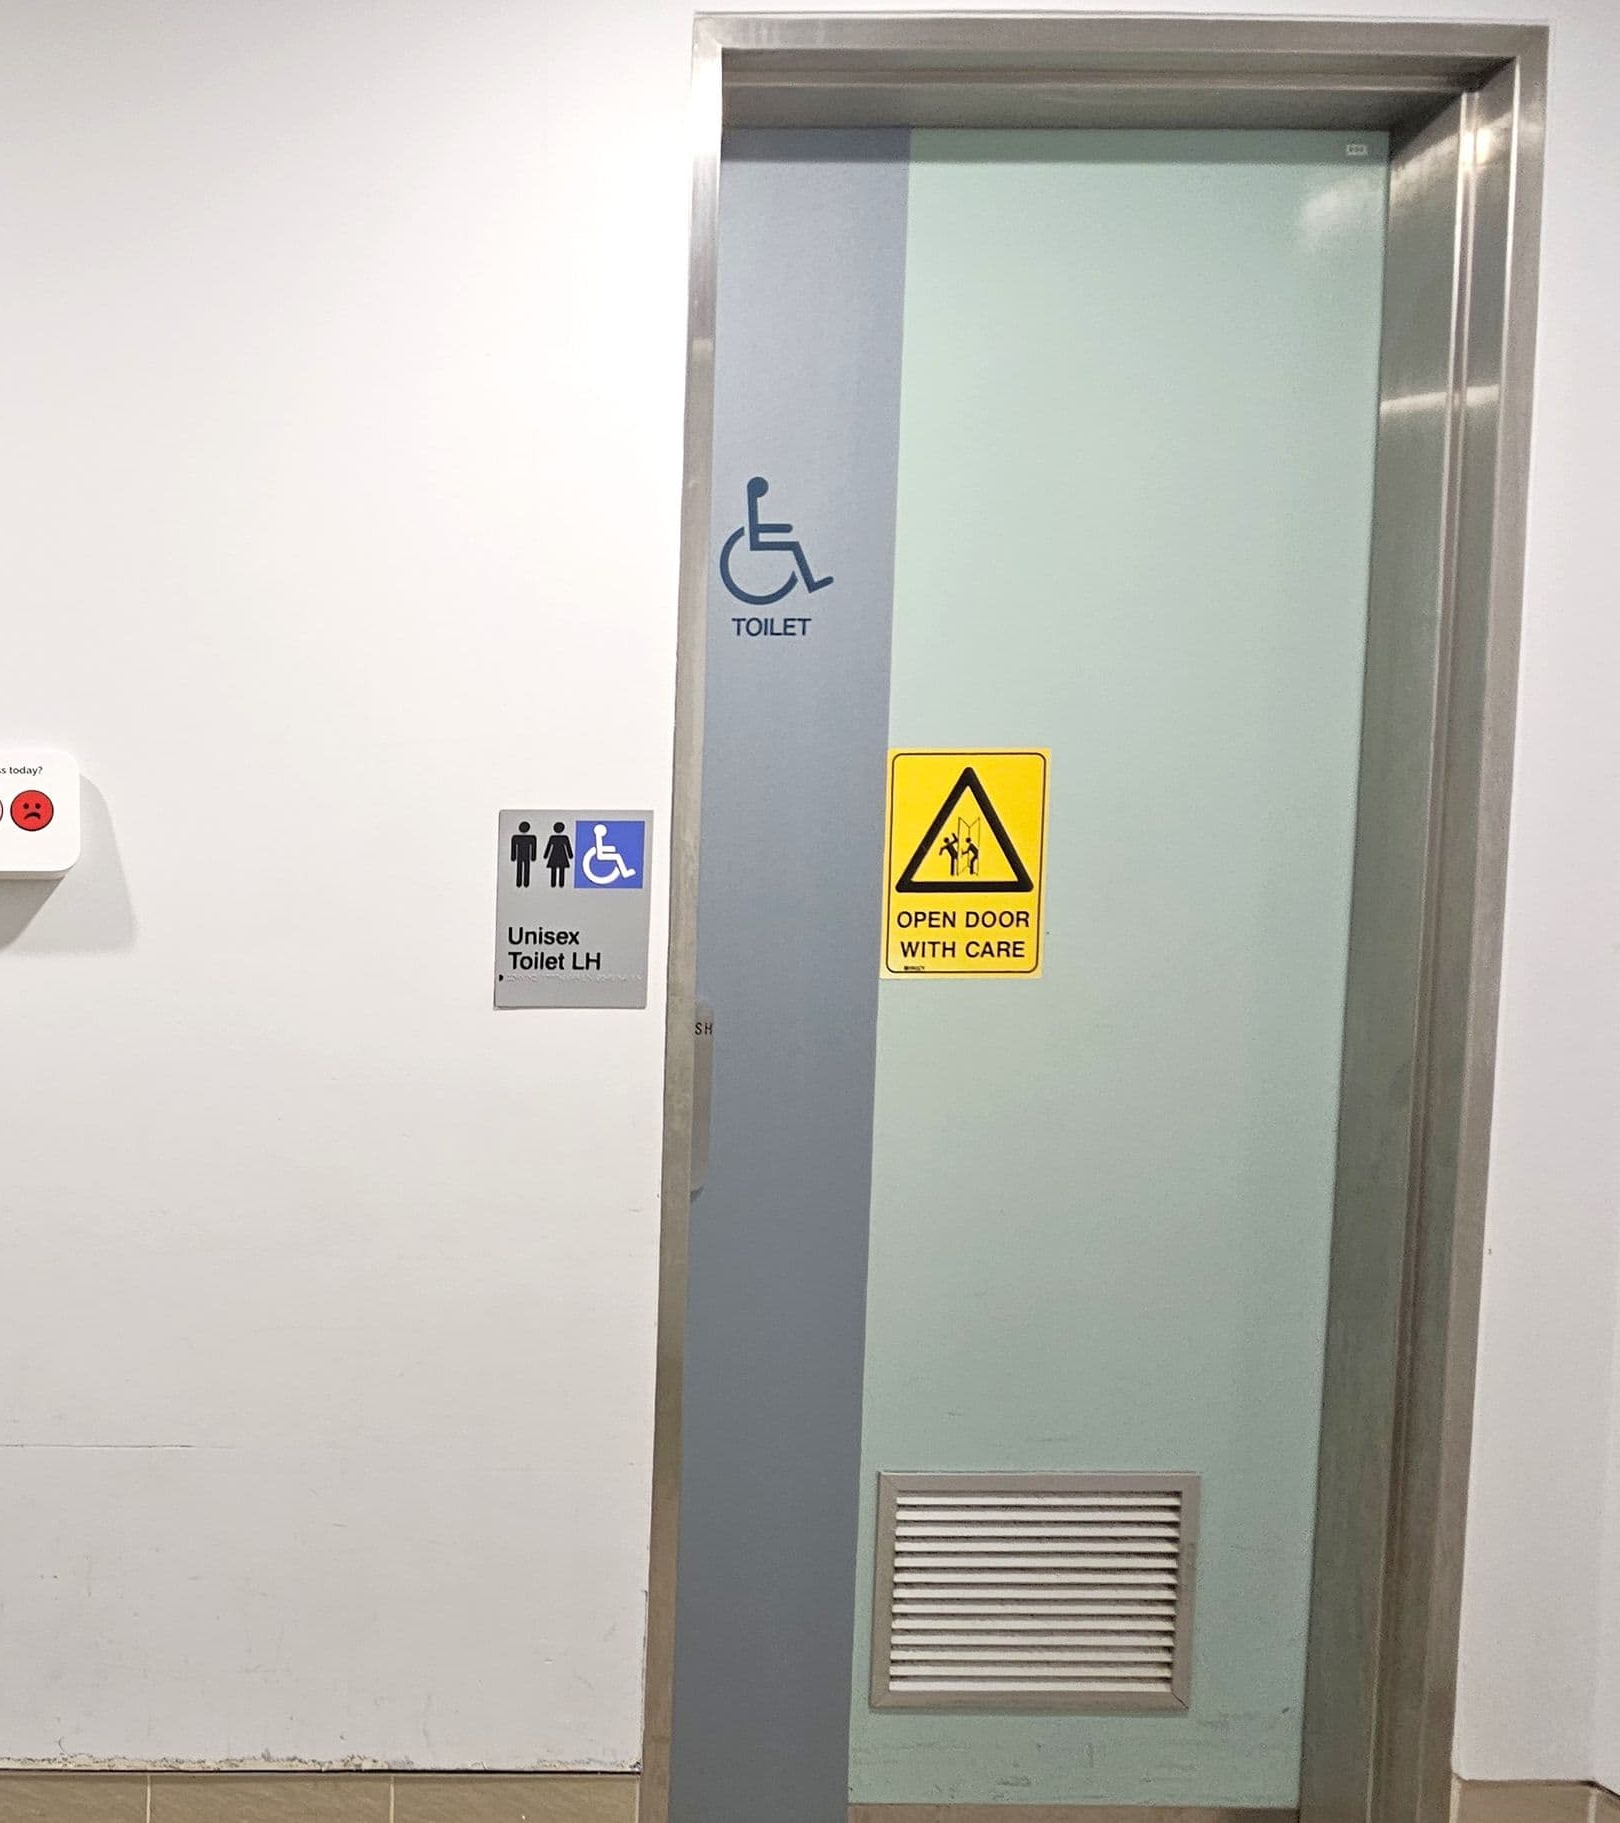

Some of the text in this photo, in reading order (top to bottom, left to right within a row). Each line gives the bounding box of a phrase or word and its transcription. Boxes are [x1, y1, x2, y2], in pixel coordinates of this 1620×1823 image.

[731, 617, 812, 636] TOILET
[9, 766, 43, 776] today?
[897, 911, 1030, 928] OPEN DOOR
[508, 926, 580, 945] Unisex
[900, 941, 1025, 958] WITH CARE
[508, 952, 601, 970] Toilet LH
